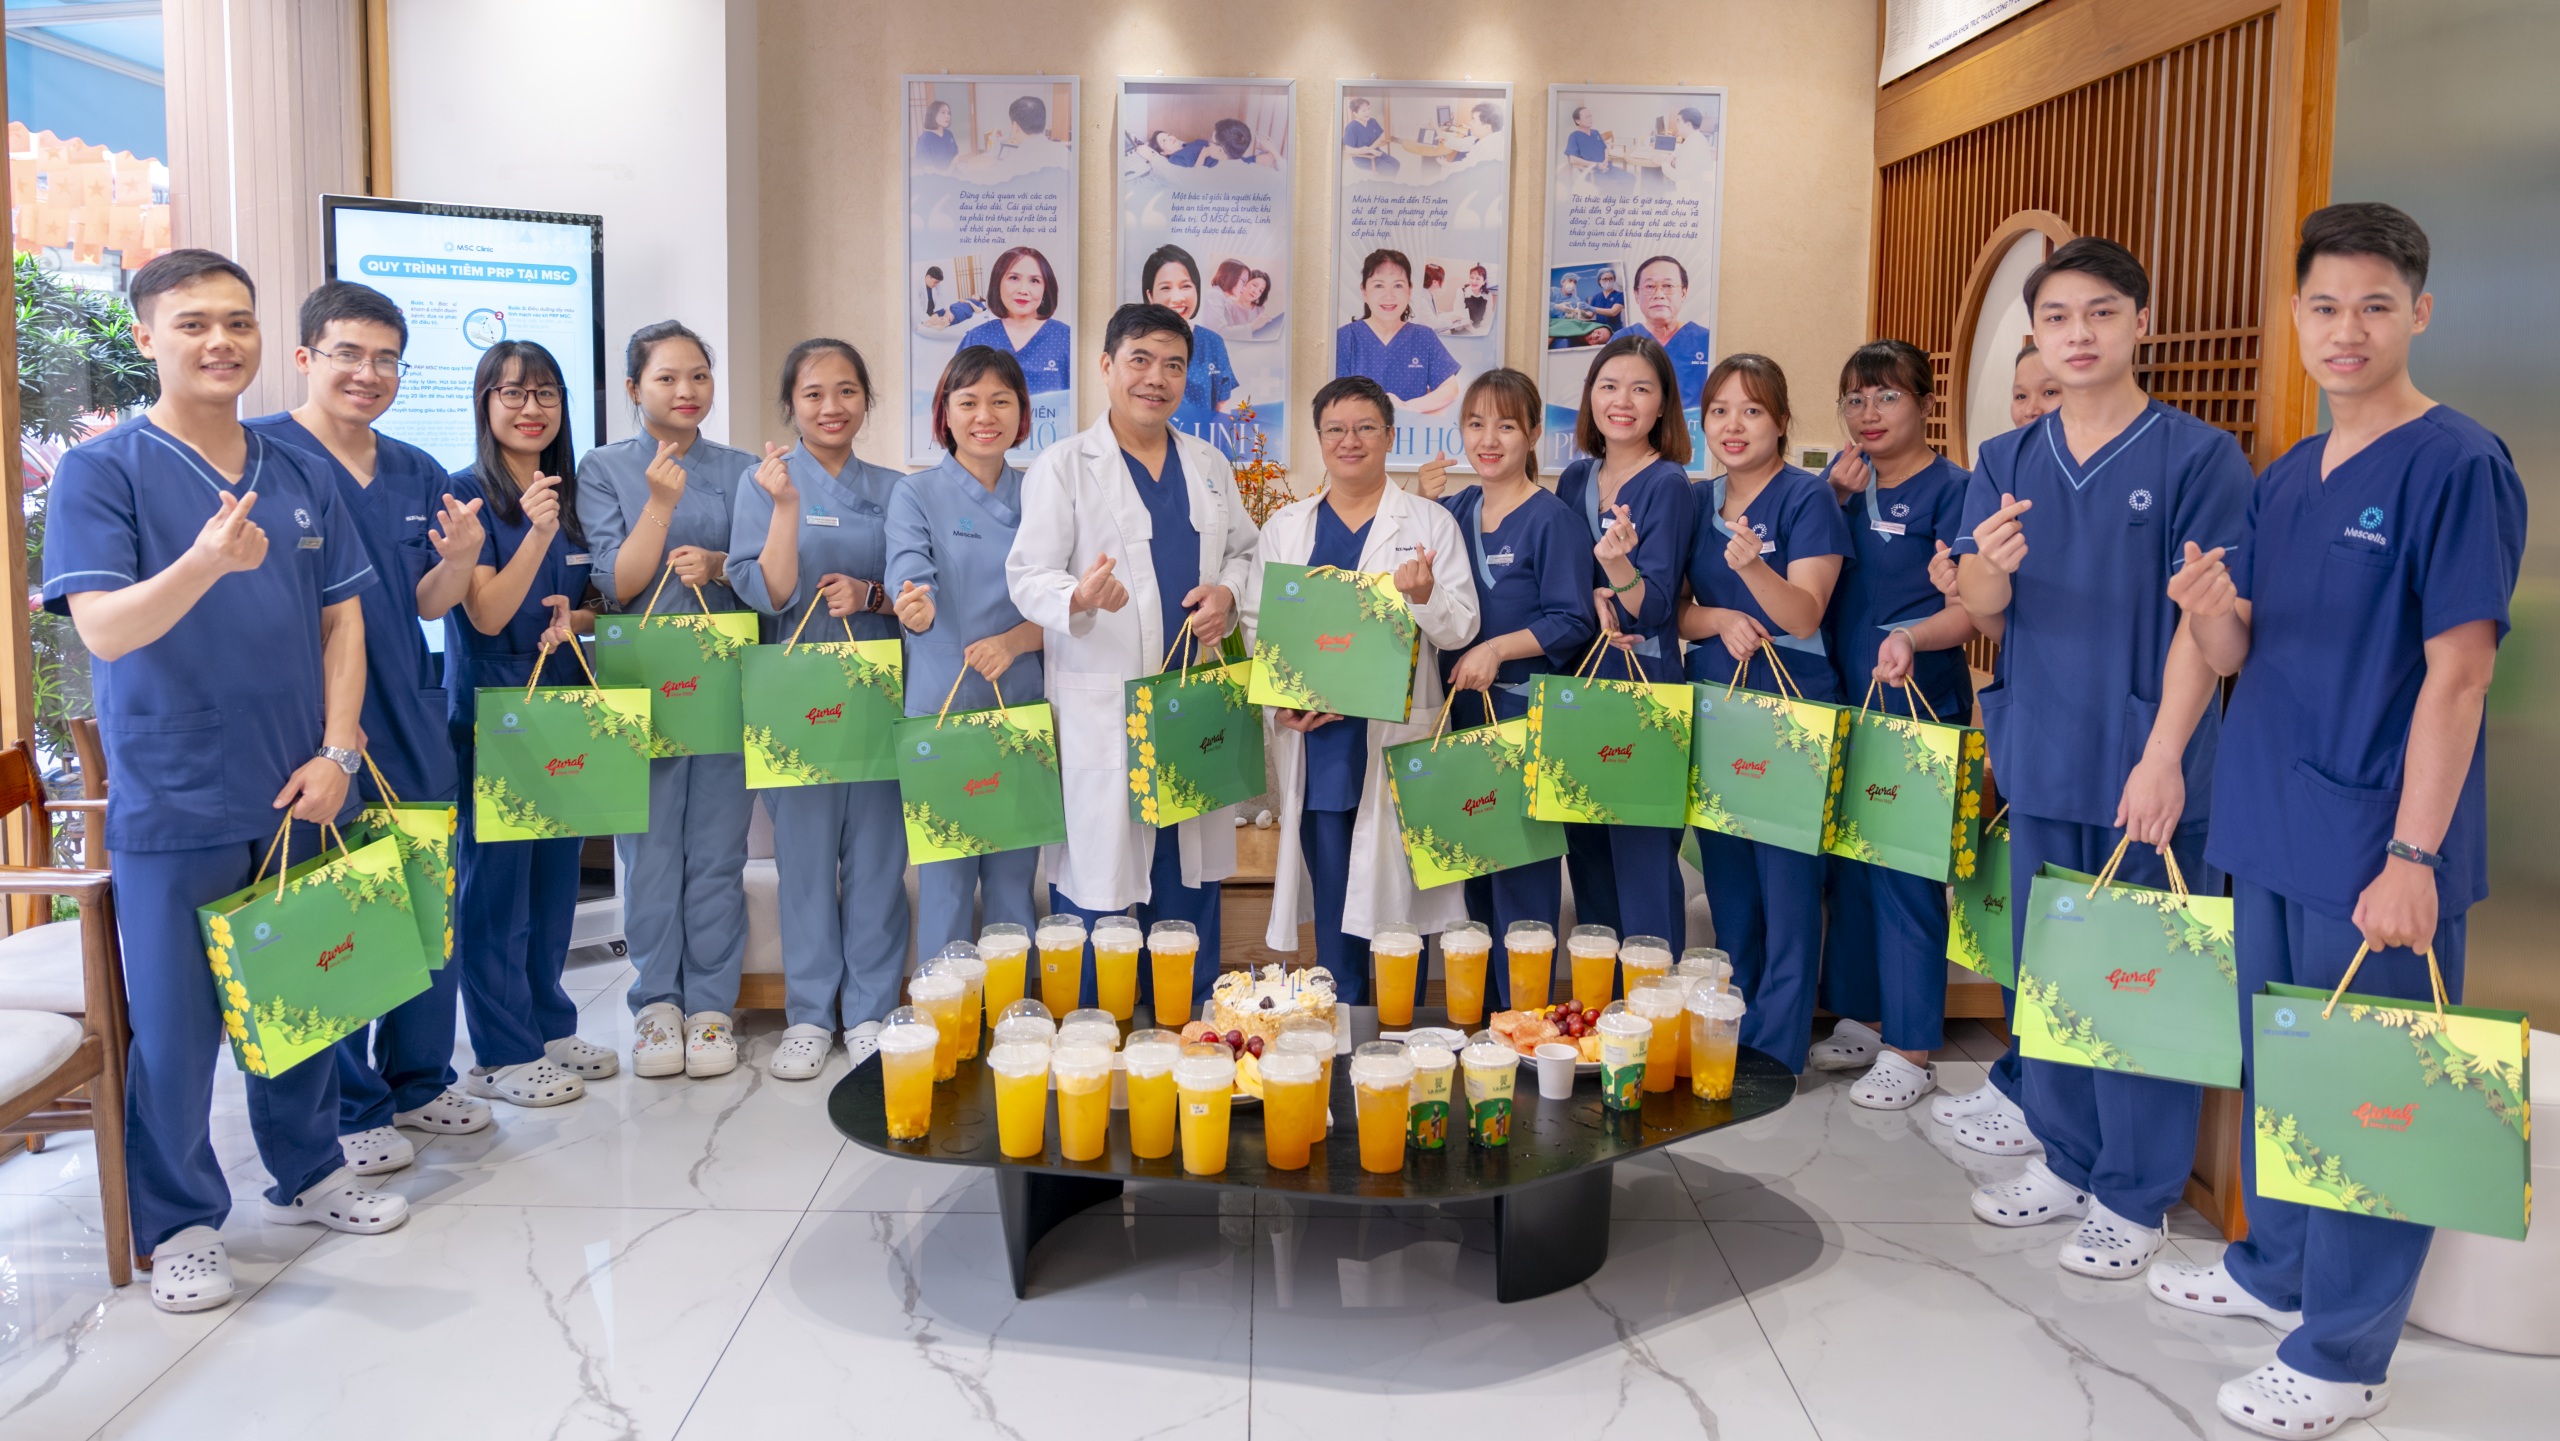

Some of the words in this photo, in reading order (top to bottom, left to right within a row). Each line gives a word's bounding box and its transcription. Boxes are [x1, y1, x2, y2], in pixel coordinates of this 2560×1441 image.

[960, 191, 980, 202] Đừng
[982, 191, 995, 199] chủ
[997, 194, 1015, 202] quan
[1172, 192, 1186, 201] Một
[1188, 192, 1201, 200] bác
[1209, 193, 1222, 203] giỏi
[1224, 193, 1230, 201] là
[1232, 194, 1251, 204] người
[1252, 193, 1271, 201] khiến
[1352, 195, 1372, 203] Minh
[1374, 195, 1389, 204] Hòa
[1391, 196, 1405, 204] mất
[1422, 196, 1431, 204] 15
[1572, 194, 1583, 203] Tôi
[1603, 196, 1617, 206] dậy
[1619, 196, 1630, 204] lúc
[1633, 196, 1639, 204] 6
[1640, 197, 1652, 208] giờ
[1654, 197, 1673, 208] sáng,
[1676, 197, 1699, 208] nhưng
[960, 202, 973, 210] đau
[976, 202, 988, 210] kéo
[990, 203, 1003, 211] dài.
[1007, 202, 1019, 211] Cái
[1021, 205, 1033, 214] giá
[1035, 203, 1057, 214] chúng
[1171, 203, 1185, 212] bạn
[1212, 207, 1229, 216] ngay
[1260, 205, 1271, 213] khi
[1398, 207, 1425, 218] phương
[1429, 207, 1448, 218] pháp
[1569, 206, 1586, 217] phải
[1606, 206, 1612, 214] 9
[1613, 209, 1625, 218] giờ
[1671, 209, 1686, 217] chịu
[968, 213, 984, 224] phải
[986, 214, 996, 222] trả
[997, 214, 1013, 223] thực
[1025, 214, 1035, 222] rất
[1037, 214, 1047, 222] lớn
[1188, 216, 1198, 224] trị.
[1201, 213, 1208, 223] Ở
[1210, 215, 1229, 223] MSC
[1231, 215, 1252, 224] Clinic,
[1255, 216, 1271, 224] Linh
[1352, 217, 1367, 226] điều
[1369, 219, 1378, 227] trị
[1381, 218, 1400, 226] Thoái
[1402, 218, 1415, 226] hóa
[1430, 219, 1447, 230] sống
[1595, 217, 1606, 225] Cả
[1609, 217, 1624, 225] buổi
[1628, 219, 1645, 230] sáng
[970, 225, 984, 233] thời
[986, 226, 1003, 236] gian,
[1007, 225, 1020, 233] tiền
[1023, 225, 1035, 234] bạc
[1185, 226, 1201, 237] thấy
[1202, 226, 1219, 236] được
[1237, 227, 1248, 235] đó.
[1351, 228, 1361, 236] cổ
[1360, 229, 1375, 240] phù
[1377, 229, 1391, 240] hợp.
[1587, 229, 1605, 239] giùm
[1619, 228, 1625, 237] ổ
[1625, 229, 1642, 238] khóa
[1644, 230, 1661, 241] đang
[1663, 230, 1680, 238] khoá
[1682, 230, 1698, 240] chặt
[973, 235, 990, 244] khỏe
[1588, 241, 1600, 250] tay
[1602, 240, 1620, 248] mình
[1622, 241, 1632, 249] lại.
[368, 261, 399, 272] QUY
[403, 261, 447, 275] TRÌNH
[450, 263, 484, 277] TIÊM
[487, 267, 515, 278] PRP
[517, 269, 538, 282] TẠI
[542, 271, 571, 281] MSC
[1425, 422, 1467, 456] HÒ
[953, 530, 982, 539] Mescells
[2344, 527, 2387, 546] Mescells
[1314, 634, 1352, 651] Givral
[660, 676, 697, 698] Givral
[805, 703, 842, 725] Givral
[1199, 729, 1224, 754] Givral
[1598, 744, 1632, 763] Givral
[544, 754, 584, 776] Givral
[1731, 758, 1766, 775] Givral
[963, 773, 999, 797] Givral
[1866, 784, 1897, 801] Givral
[1462, 790, 1496, 817] Givral
[316, 934, 354, 972] Givral
[2105, 968, 2156, 990] Givral
[2352, 1102, 2414, 1128] Givral
